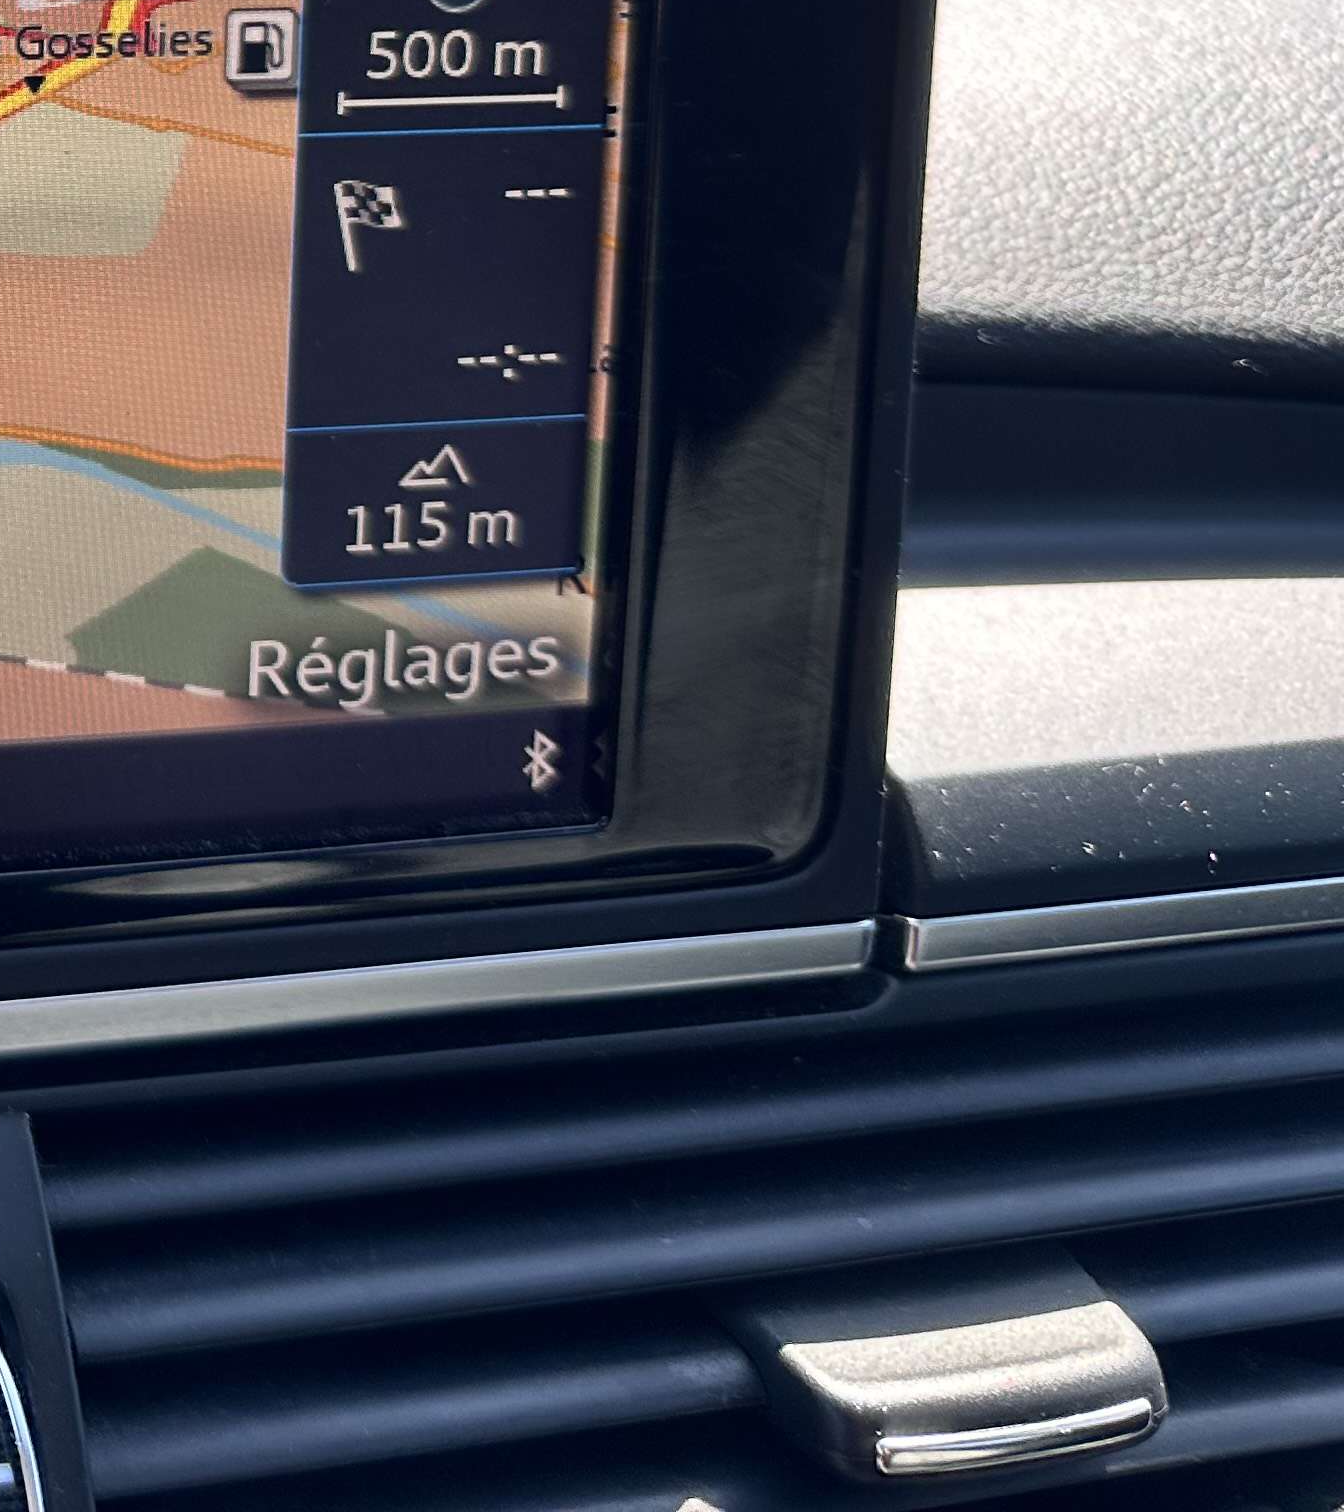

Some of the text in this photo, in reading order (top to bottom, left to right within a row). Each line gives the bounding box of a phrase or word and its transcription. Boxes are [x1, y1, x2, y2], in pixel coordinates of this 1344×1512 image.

[15, 23, 214, 59] Gosselies
[366, 29, 545, 79] 500 m
[346, 501, 517, 552] 115 m
[248, 629, 561, 707] Réglages
